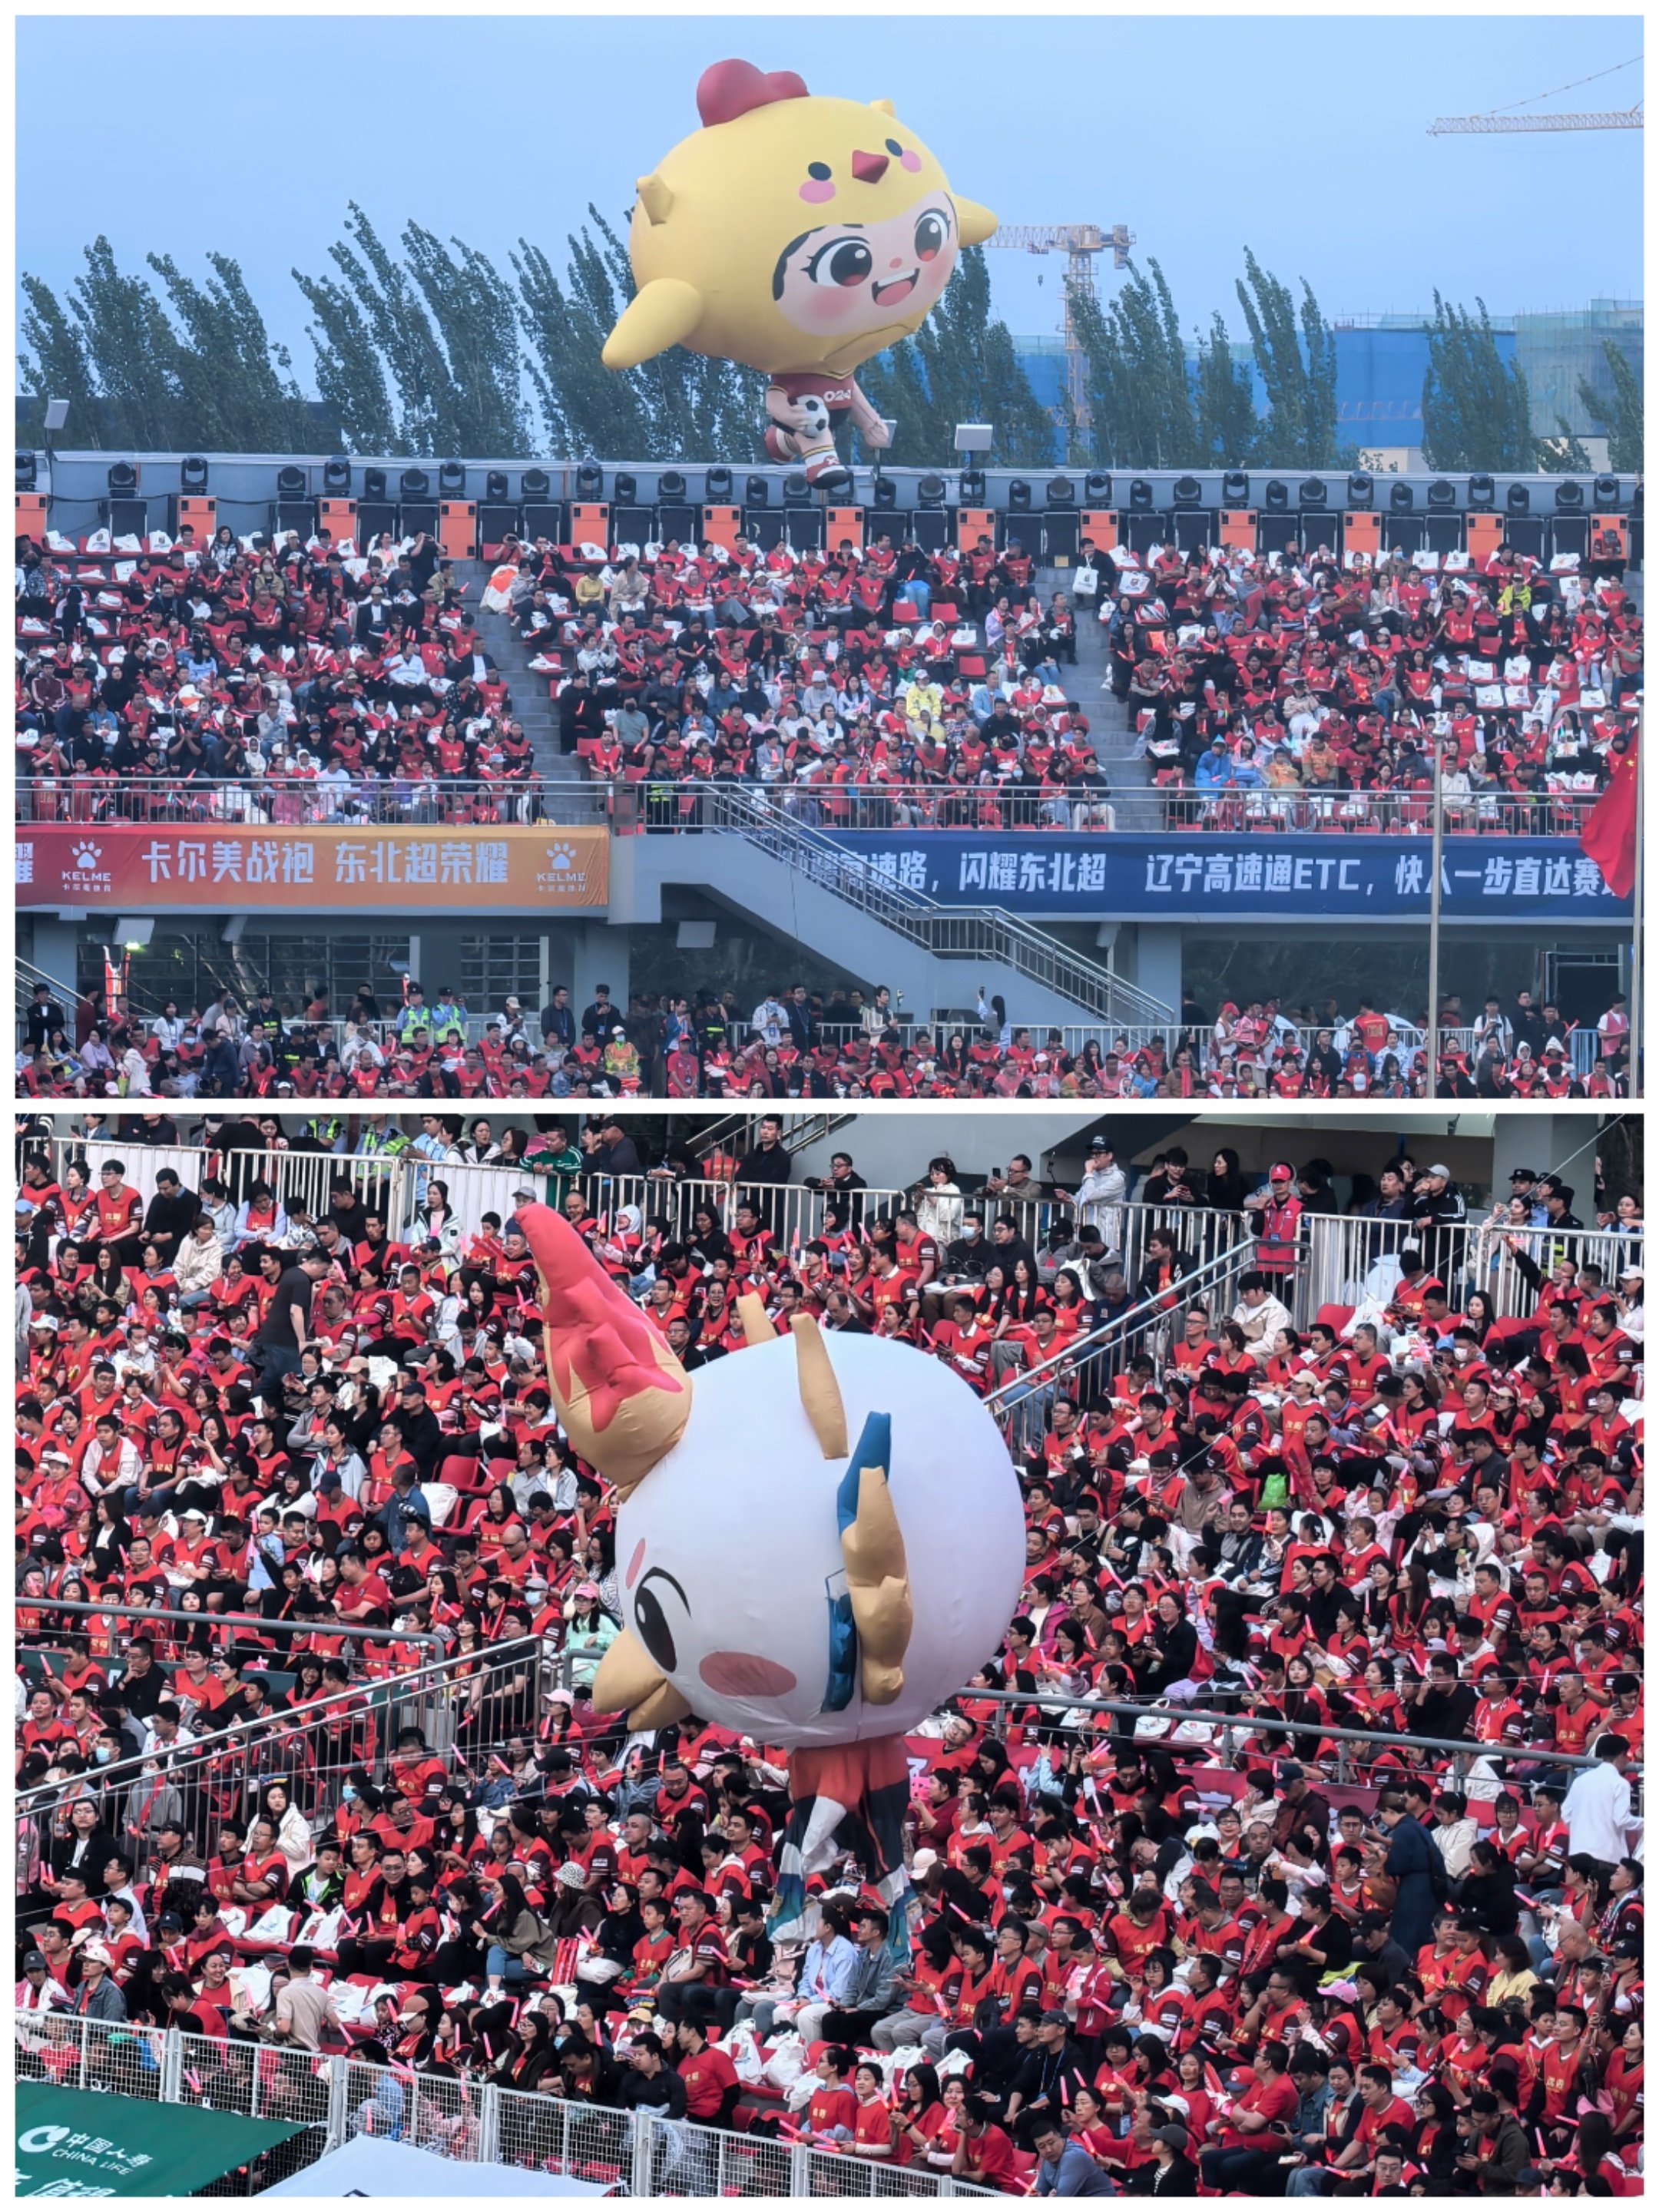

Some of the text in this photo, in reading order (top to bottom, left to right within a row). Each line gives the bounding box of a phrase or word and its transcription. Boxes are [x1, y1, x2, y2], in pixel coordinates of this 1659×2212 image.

[823, 389, 852, 402] 024
[141, 840, 508, 882] 卡尔美战袍 东北超荣耀
[61, 872, 111, 882] KELME
[537, 873, 586, 882] KELME
[52, 2148, 133, 2176] CHINA LIFE
